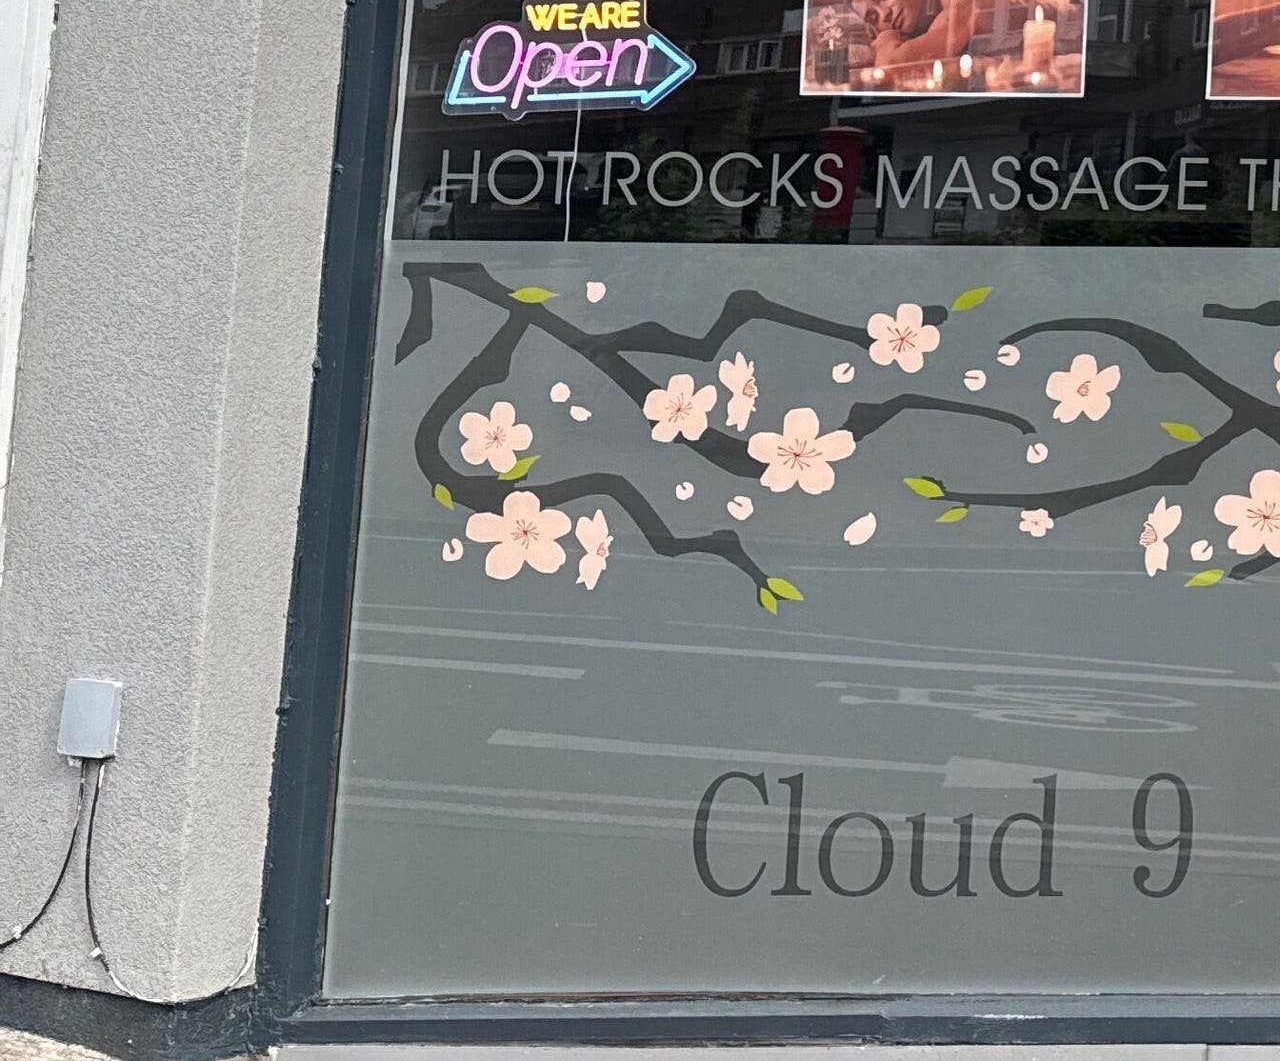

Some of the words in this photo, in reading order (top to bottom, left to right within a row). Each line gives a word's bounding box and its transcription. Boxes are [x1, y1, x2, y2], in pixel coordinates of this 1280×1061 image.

[468, 23, 650, 109] Open
[440, 148, 574, 206] HOT
[601, 149, 844, 209] ROCKS
[874, 153, 1210, 213] MASSAGE
[691, 770, 1064, 898] Cloud
[1131, 771, 1194, 898] 9
